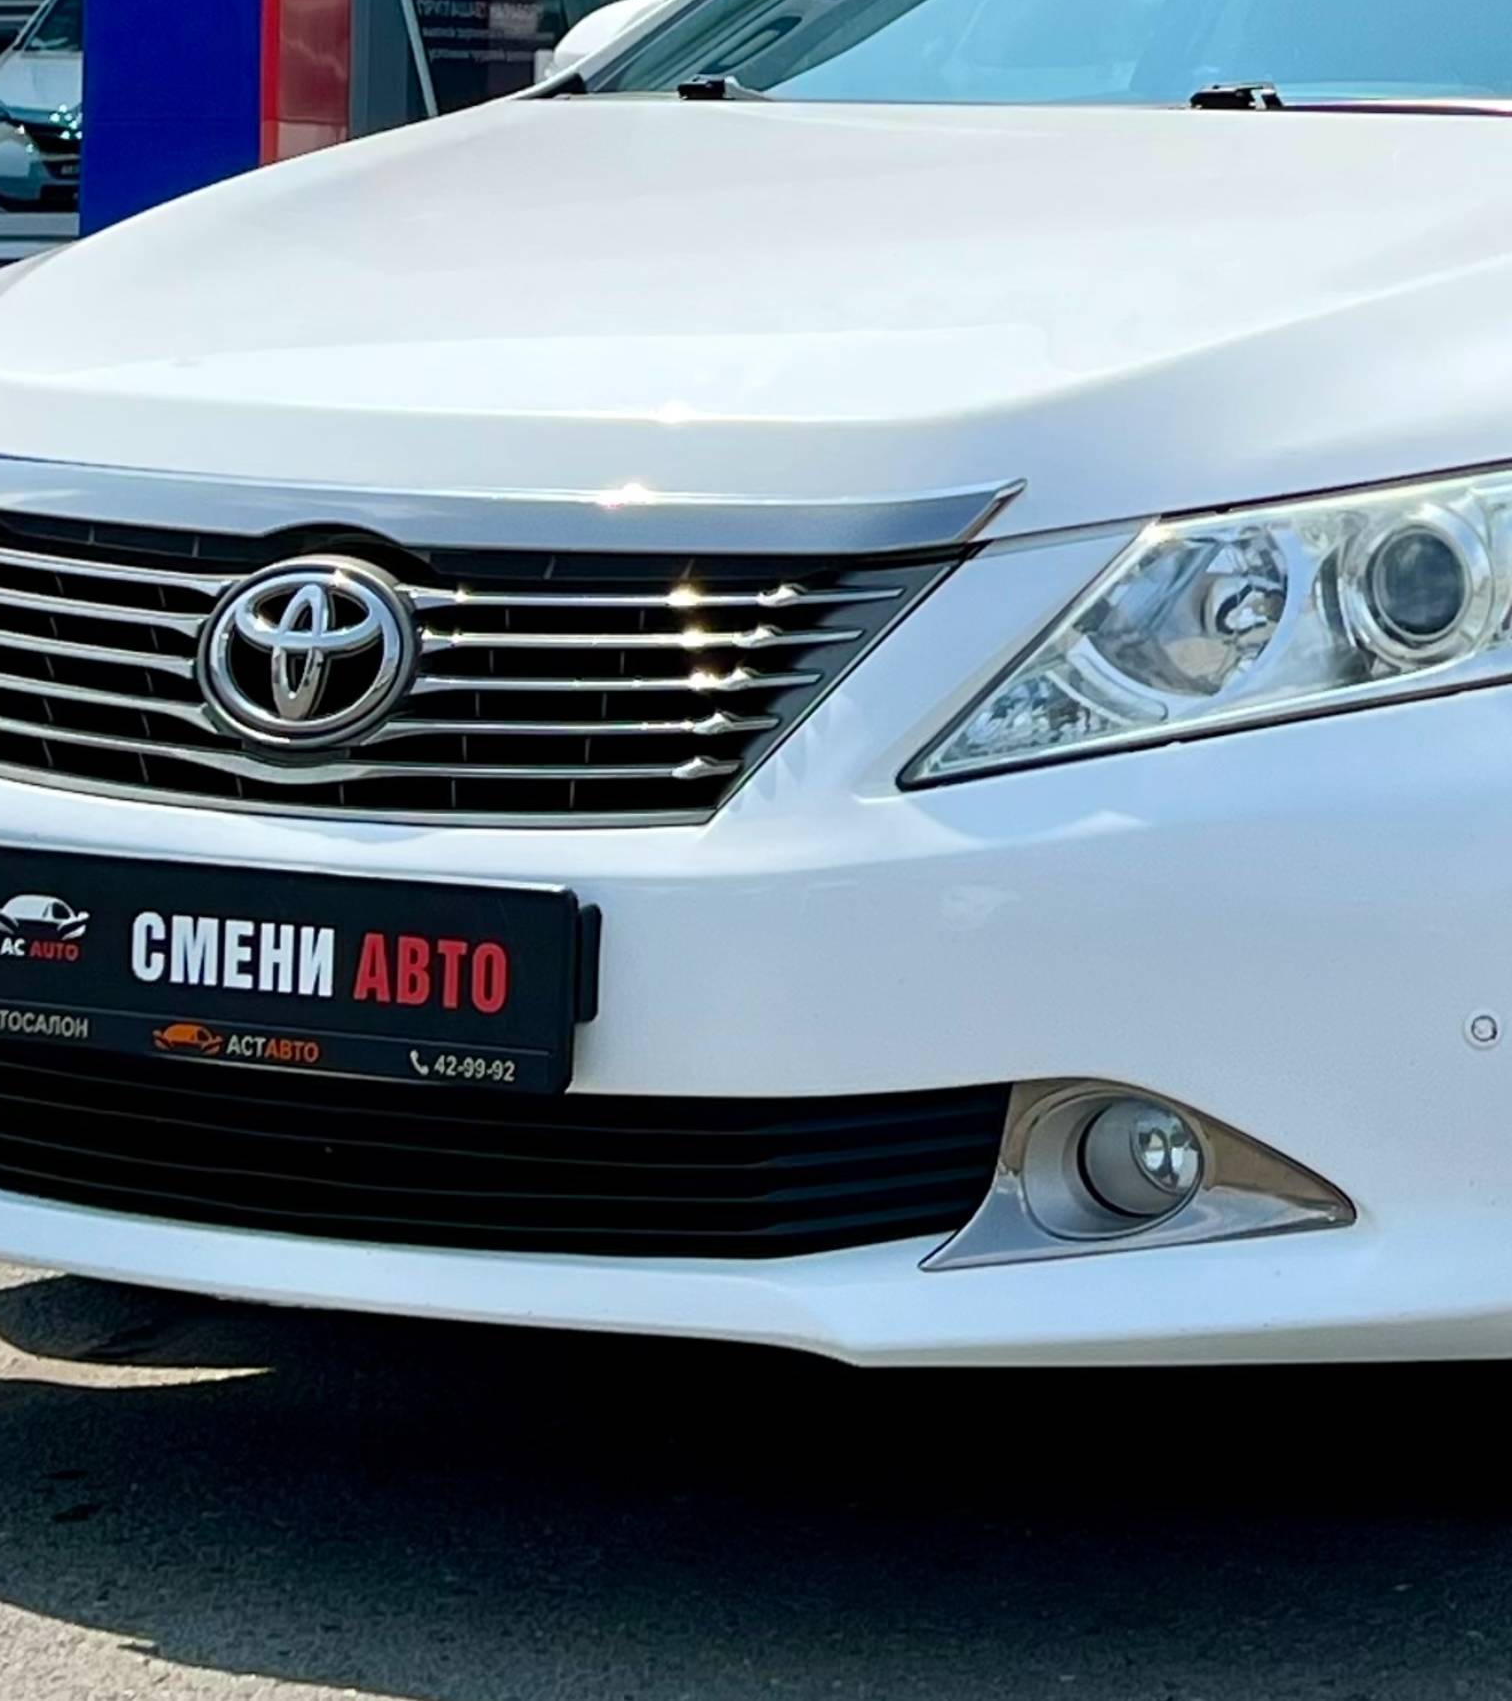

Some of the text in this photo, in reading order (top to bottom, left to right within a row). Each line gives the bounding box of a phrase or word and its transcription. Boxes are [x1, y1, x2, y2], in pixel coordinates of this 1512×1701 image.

[29, 940, 80, 961] AUTO
[131, 911, 508, 1014] СМЕНИ АВТО
[226, 1034, 321, 1064] АСТАВТО
[433, 1055, 516, 1083] 42-99-92
